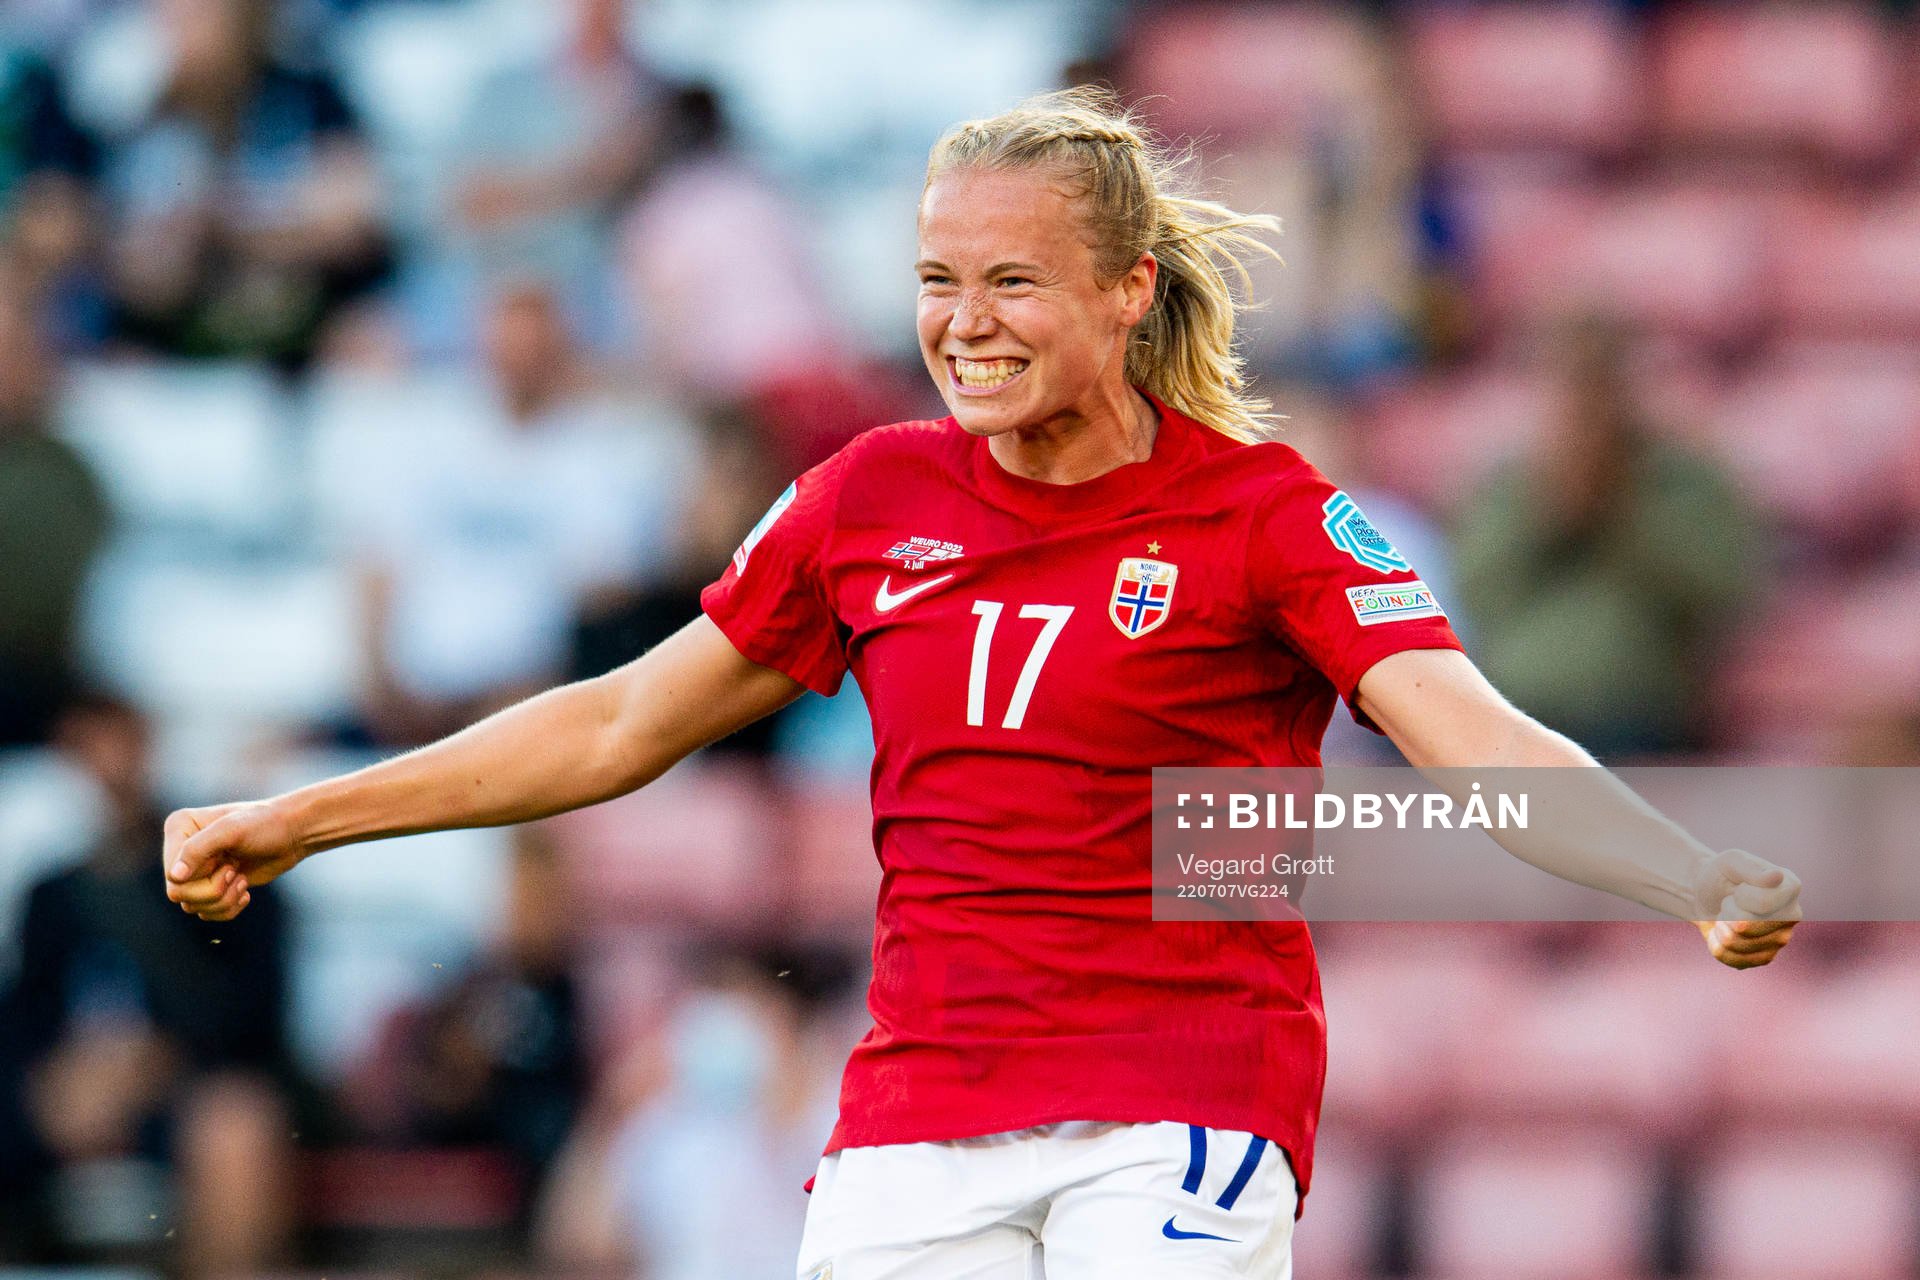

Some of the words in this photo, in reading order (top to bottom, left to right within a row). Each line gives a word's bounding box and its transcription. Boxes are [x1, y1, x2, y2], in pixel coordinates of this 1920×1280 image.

[1349, 518, 1367, 527] We
[910, 536, 941, 547] WEURO
[941, 541, 963, 553] 2022
[1361, 537, 1386, 545] Stro
[1351, 588, 1376, 599] UEFA
[967, 599, 1076, 730] 17
